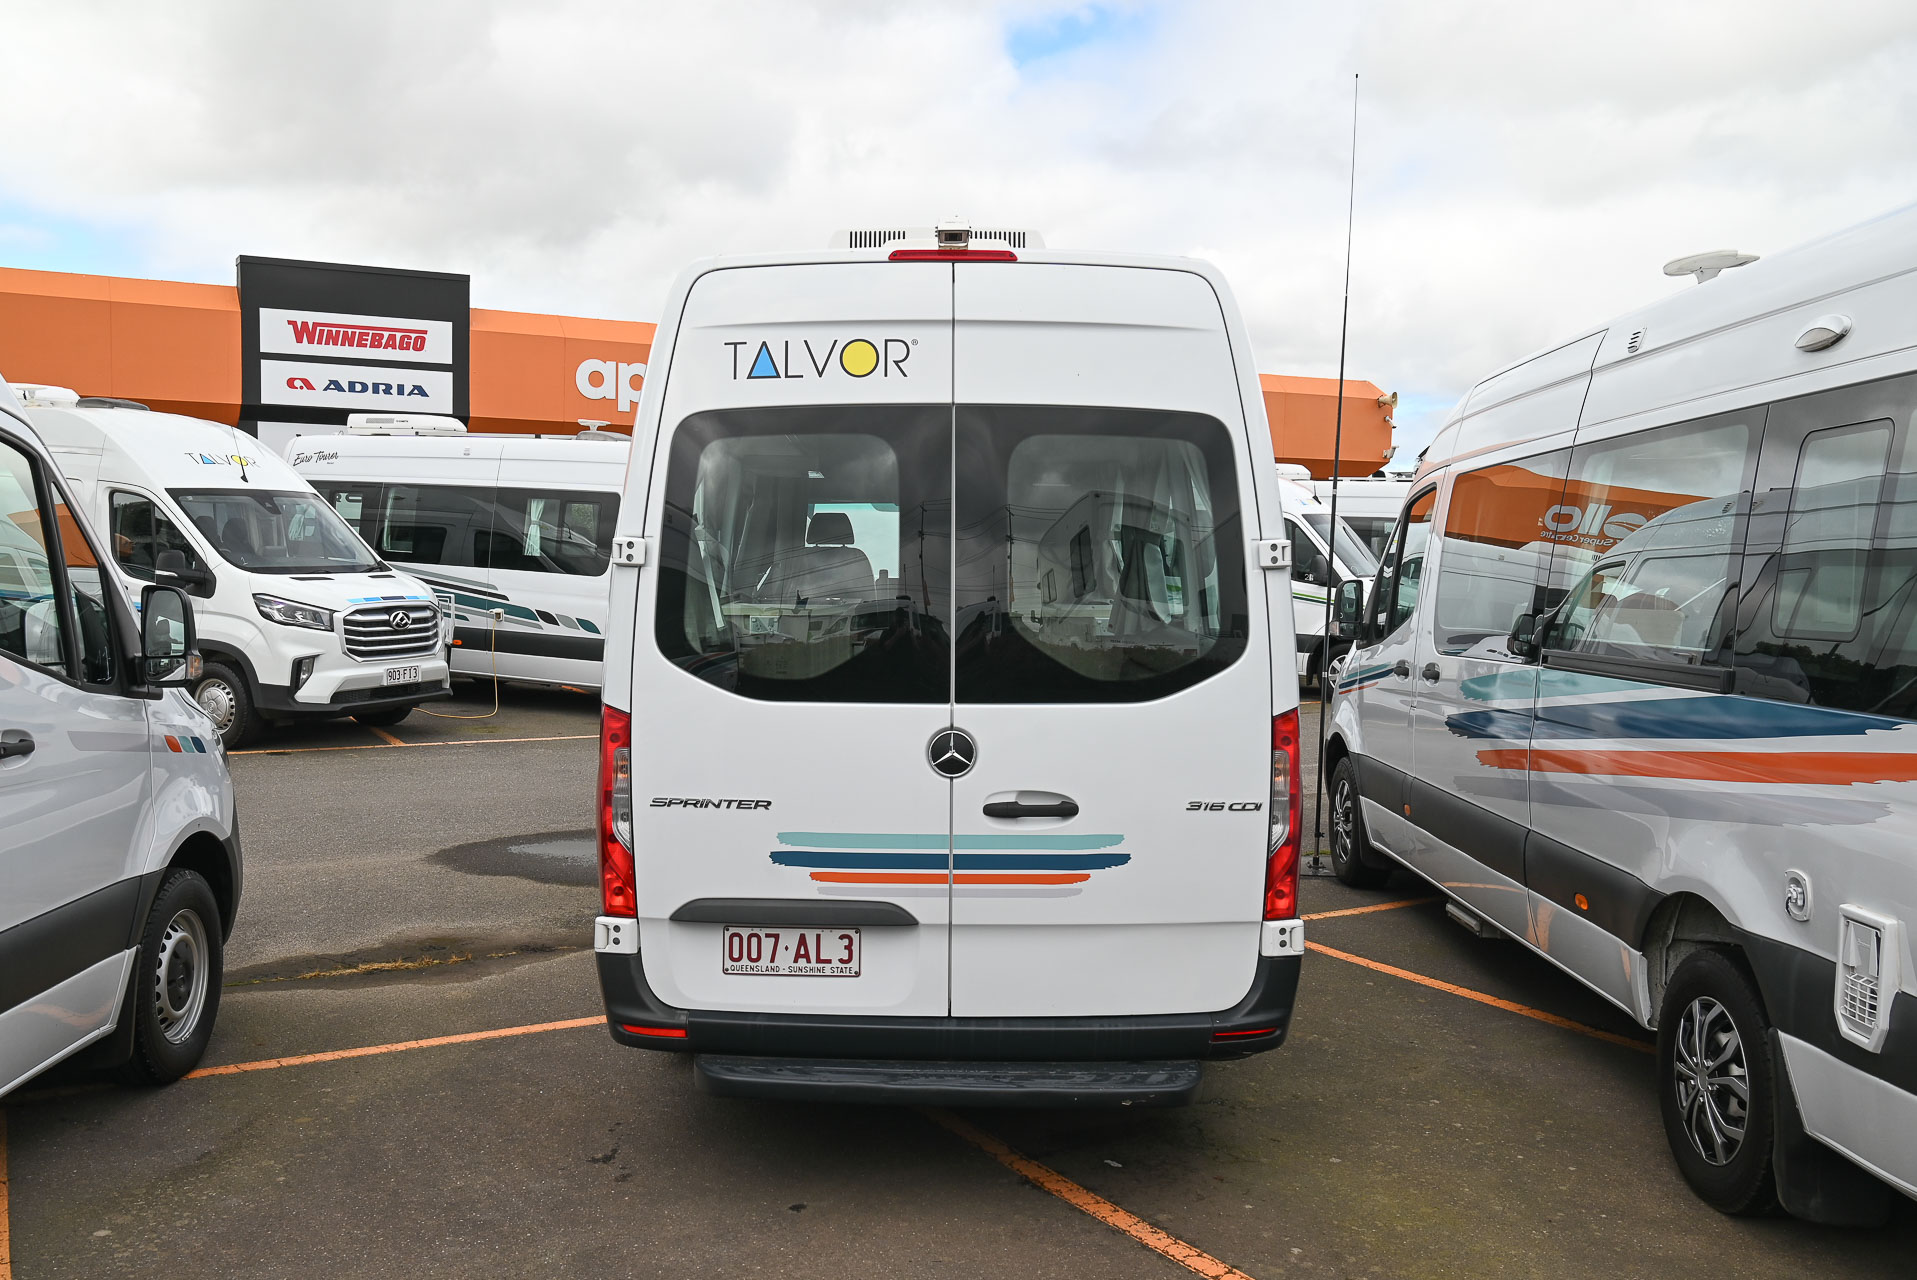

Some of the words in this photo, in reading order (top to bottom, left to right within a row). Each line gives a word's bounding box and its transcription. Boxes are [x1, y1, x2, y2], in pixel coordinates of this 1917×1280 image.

[287, 319, 428, 352] WINNEBAGO
[322, 379, 430, 397] ADRIA
[184, 452, 261, 468] TALVOR
[293, 452, 313, 466] Euro
[314, 450, 339, 463] Tourer
[650, 797, 772, 810] SPRINTER
[1186, 801, 1226, 811] 316
[1227, 801, 1264, 811] CDI
[730, 964, 781, 973] QUEENSLAND
[787, 966, 826, 974] SUNSHINE
[830, 966, 853, 974] STATE
